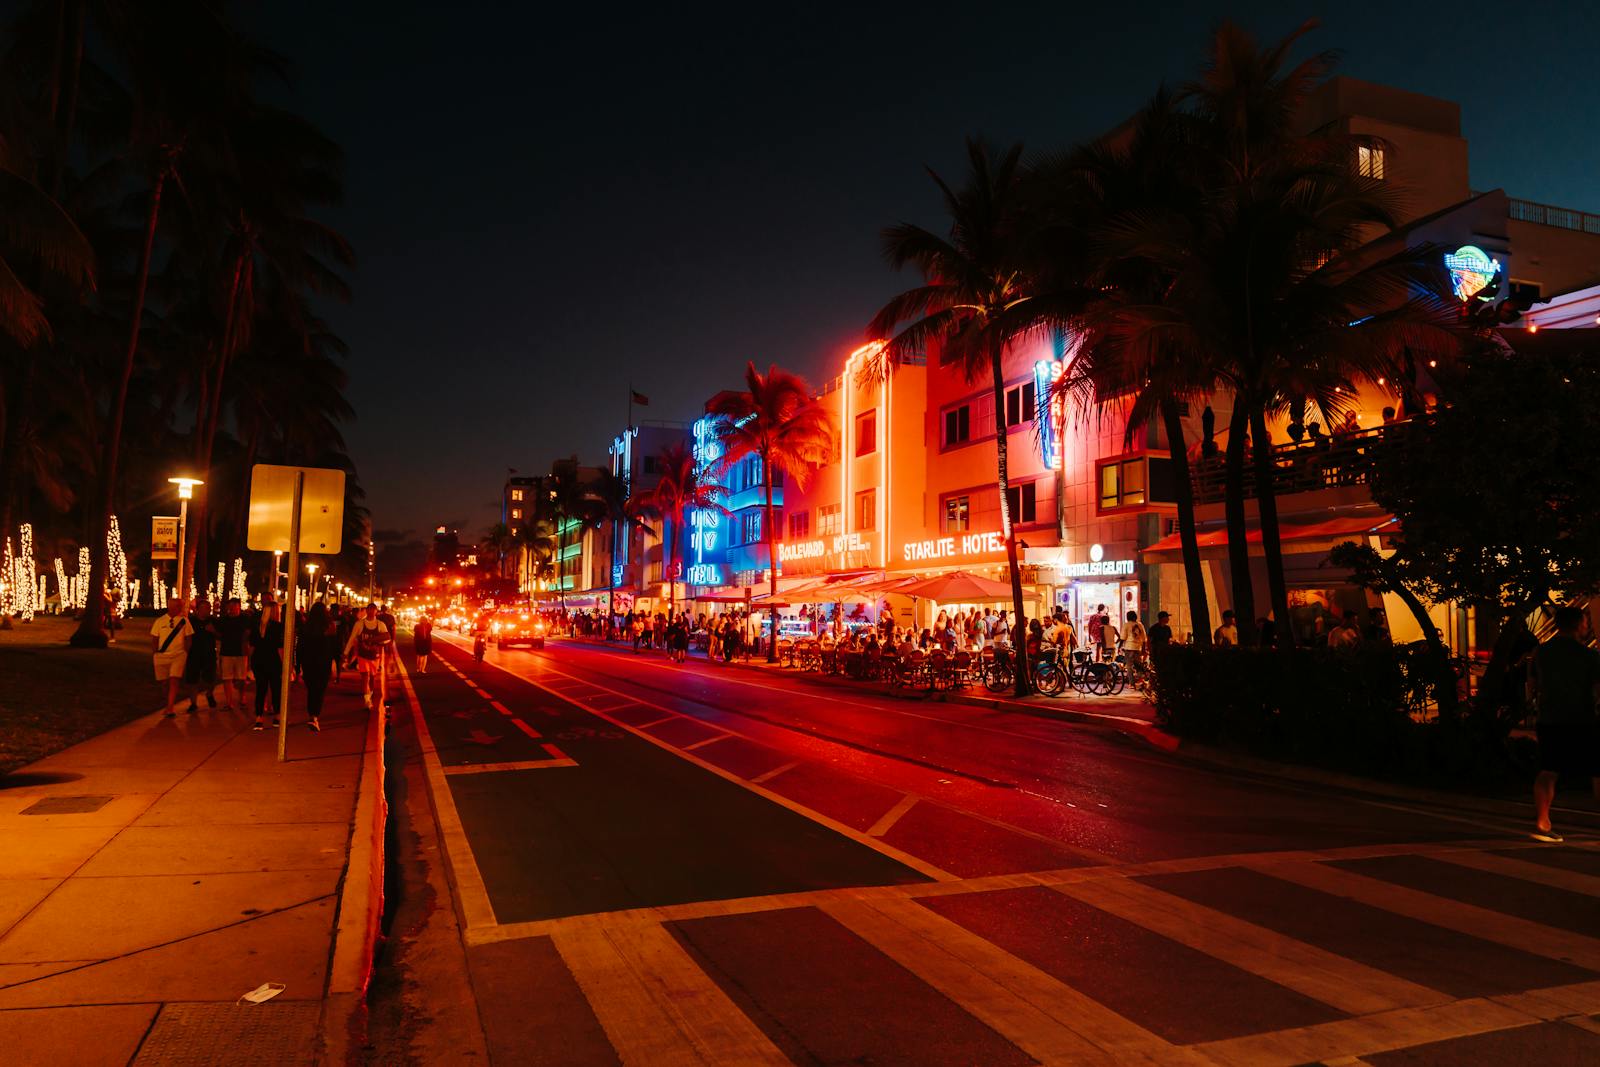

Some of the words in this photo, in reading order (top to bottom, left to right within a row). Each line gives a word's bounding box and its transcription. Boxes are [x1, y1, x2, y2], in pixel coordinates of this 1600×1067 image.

[778, 540, 825, 562] BOULEVARD
[833, 533, 866, 554] HOTEL
[904, 537, 955, 561] STARLITE
[962, 531, 1007, 554] HOTEL
[1103, 560, 1134, 575] GELATO
